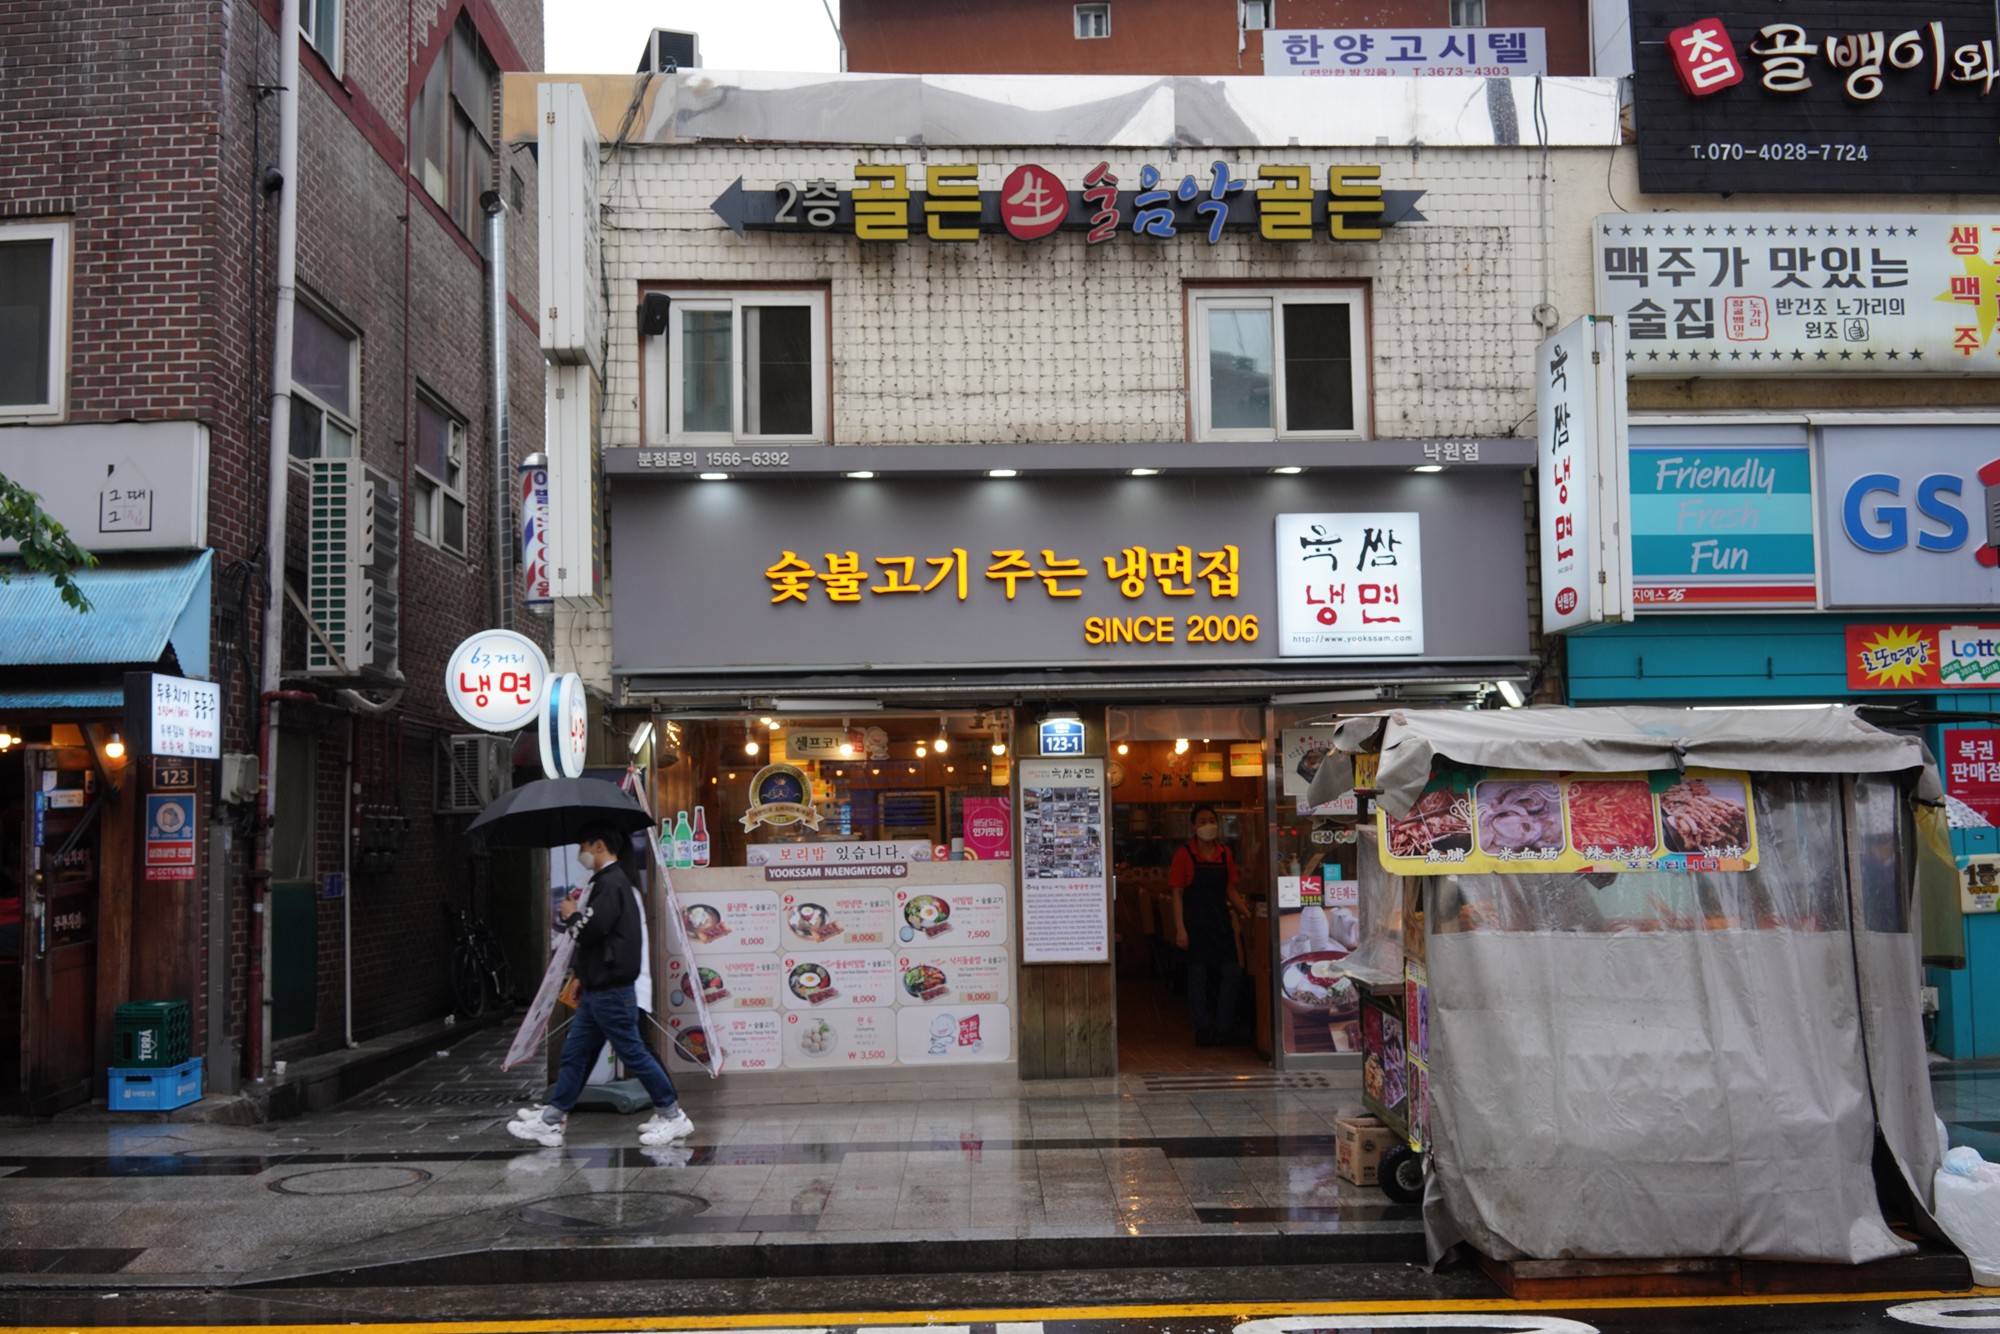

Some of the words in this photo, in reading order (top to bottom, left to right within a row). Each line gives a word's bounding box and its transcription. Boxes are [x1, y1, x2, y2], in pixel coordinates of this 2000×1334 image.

[1283, 33, 1528, 65] 한양고시텔
[1412, 67, 1510, 76] T.3673-4303
[1691, 145, 1868, 162] T.070-4028-7724
[774, 177, 841, 228] 2층
[851, 164, 983, 243] 골든
[1257, 164, 1386, 243] 골든
[1604, 246, 1750, 288] 맥주가
[1769, 247, 1909, 289] 맛있는
[1776, 297, 1827, 316] 반건조
[1836, 297, 1906, 317] 노가리의
[1627, 297, 1715, 340] 술집
[1805, 321, 1839, 340] 원조
[637, 452, 697, 467] 분점문의
[706, 452, 789, 466] 1566-6392
[1423, 443, 1479, 462] 낙원점
[1656, 457, 1776, 497] Friendly
[1675, 499, 1759, 532] Fresh
[1299, 525, 1403, 572] 육쌈
[1690, 540, 1749, 573] Fun
[765, 546, 968, 603] 숯불고기
[985, 548, 1089, 600] 주는
[1102, 543, 1240, 598] 냉면집
[1306, 583, 1401, 626] 냉면
[1668, 588, 1686, 602] 25
[1084, 615, 1175, 643] SINCE
[1186, 614, 1259, 642] 2006
[1862, 641, 1930, 672] 로또명당
[460, 672, 531, 707] 냉면
[1046, 736, 1079, 752] 123-1
[1959, 740, 1994, 761] 복권
[161, 769, 189, 784] 123
[779, 846, 826, 862] 보리밥
[836, 844, 905, 861] 있습니다.
[769, 867, 822, 878] YOOKSSAM
[824, 865, 891, 876] NAENGMYEON
[740, 937, 764, 945] 8,000
[851, 933, 875, 942] 8,000
[967, 930, 990, 939] 7,500
[741, 998, 765, 1007] 8,500
[852, 995, 876, 1004] 8,000
[967, 993, 991, 1001] 9,000
[741, 1059, 765, 1067] 8,500
[860, 1050, 885, 1060] 3,500
